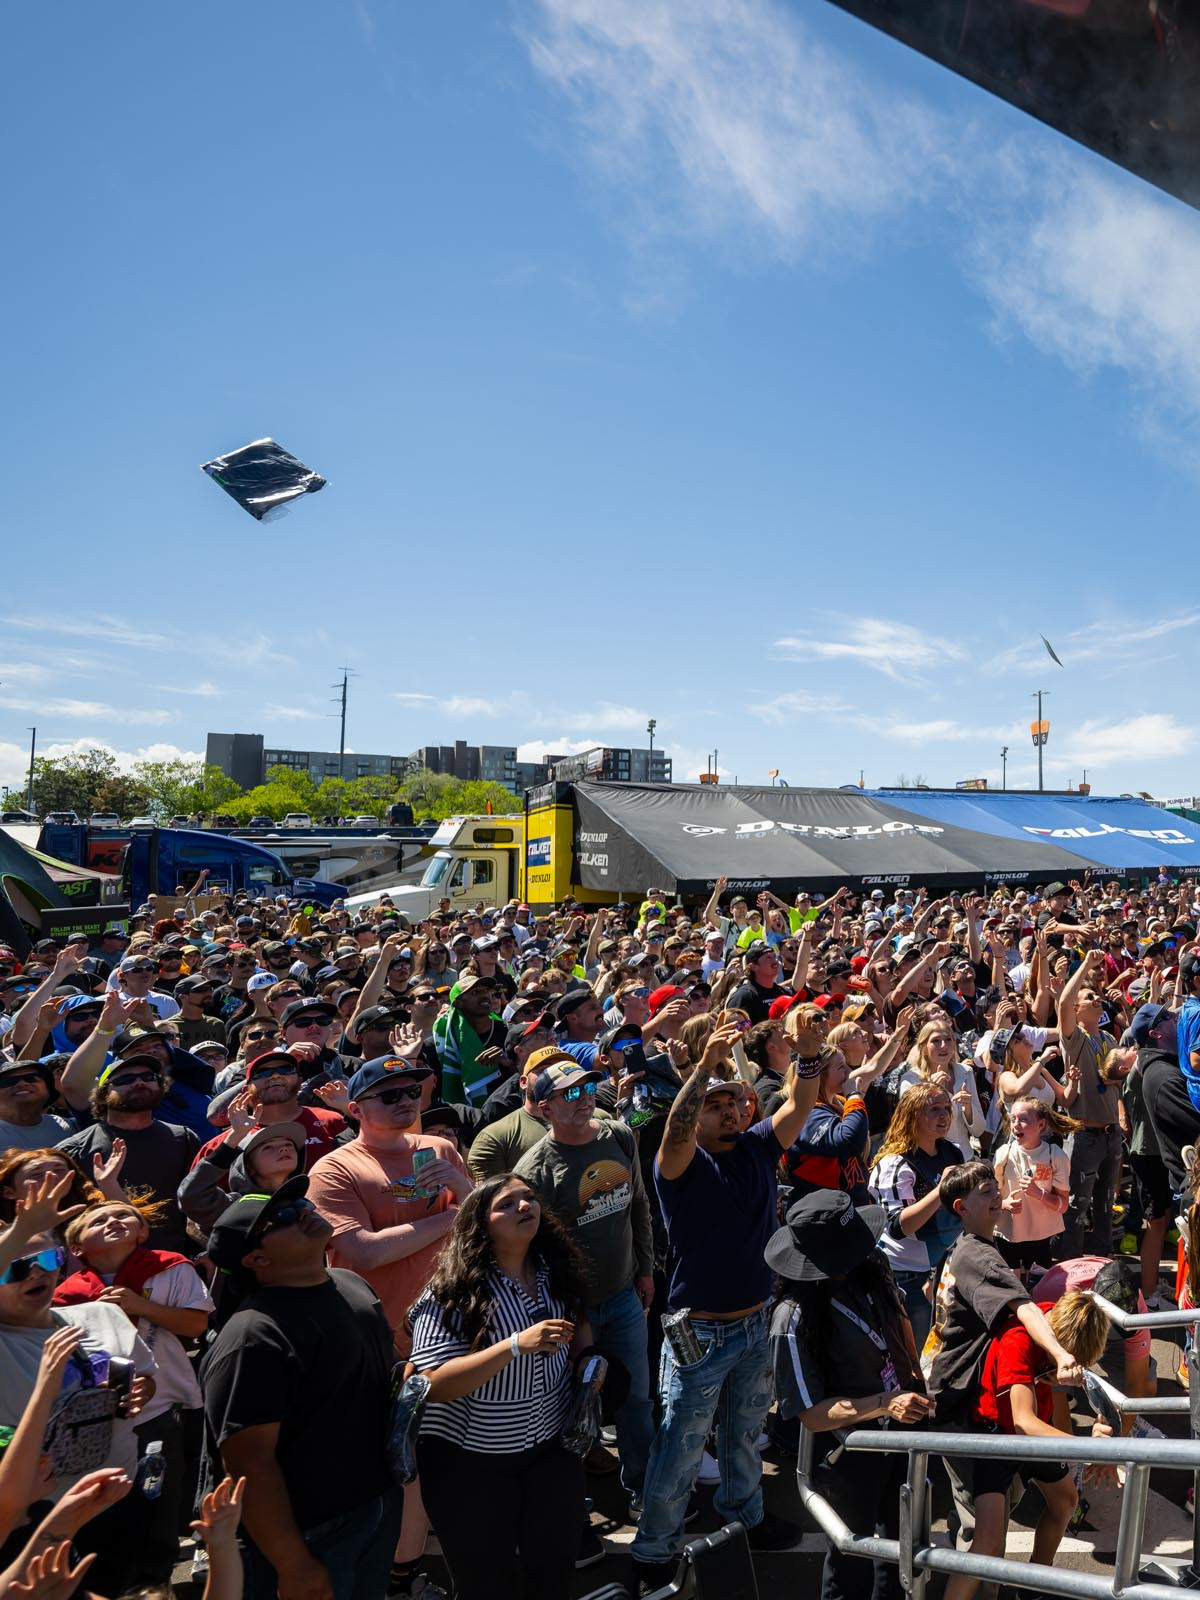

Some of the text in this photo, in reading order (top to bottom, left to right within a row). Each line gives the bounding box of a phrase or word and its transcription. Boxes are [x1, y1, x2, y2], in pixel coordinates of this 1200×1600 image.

[735, 820, 945, 835] DUNLOP
[1023, 824, 1185, 838] FALKEN
[580, 832, 608, 843] DUNLOP
[577, 852, 608, 867] FALKEN
[861, 875, 910, 884] FALKEN
[992, 872, 1029, 880] DUNLOP
